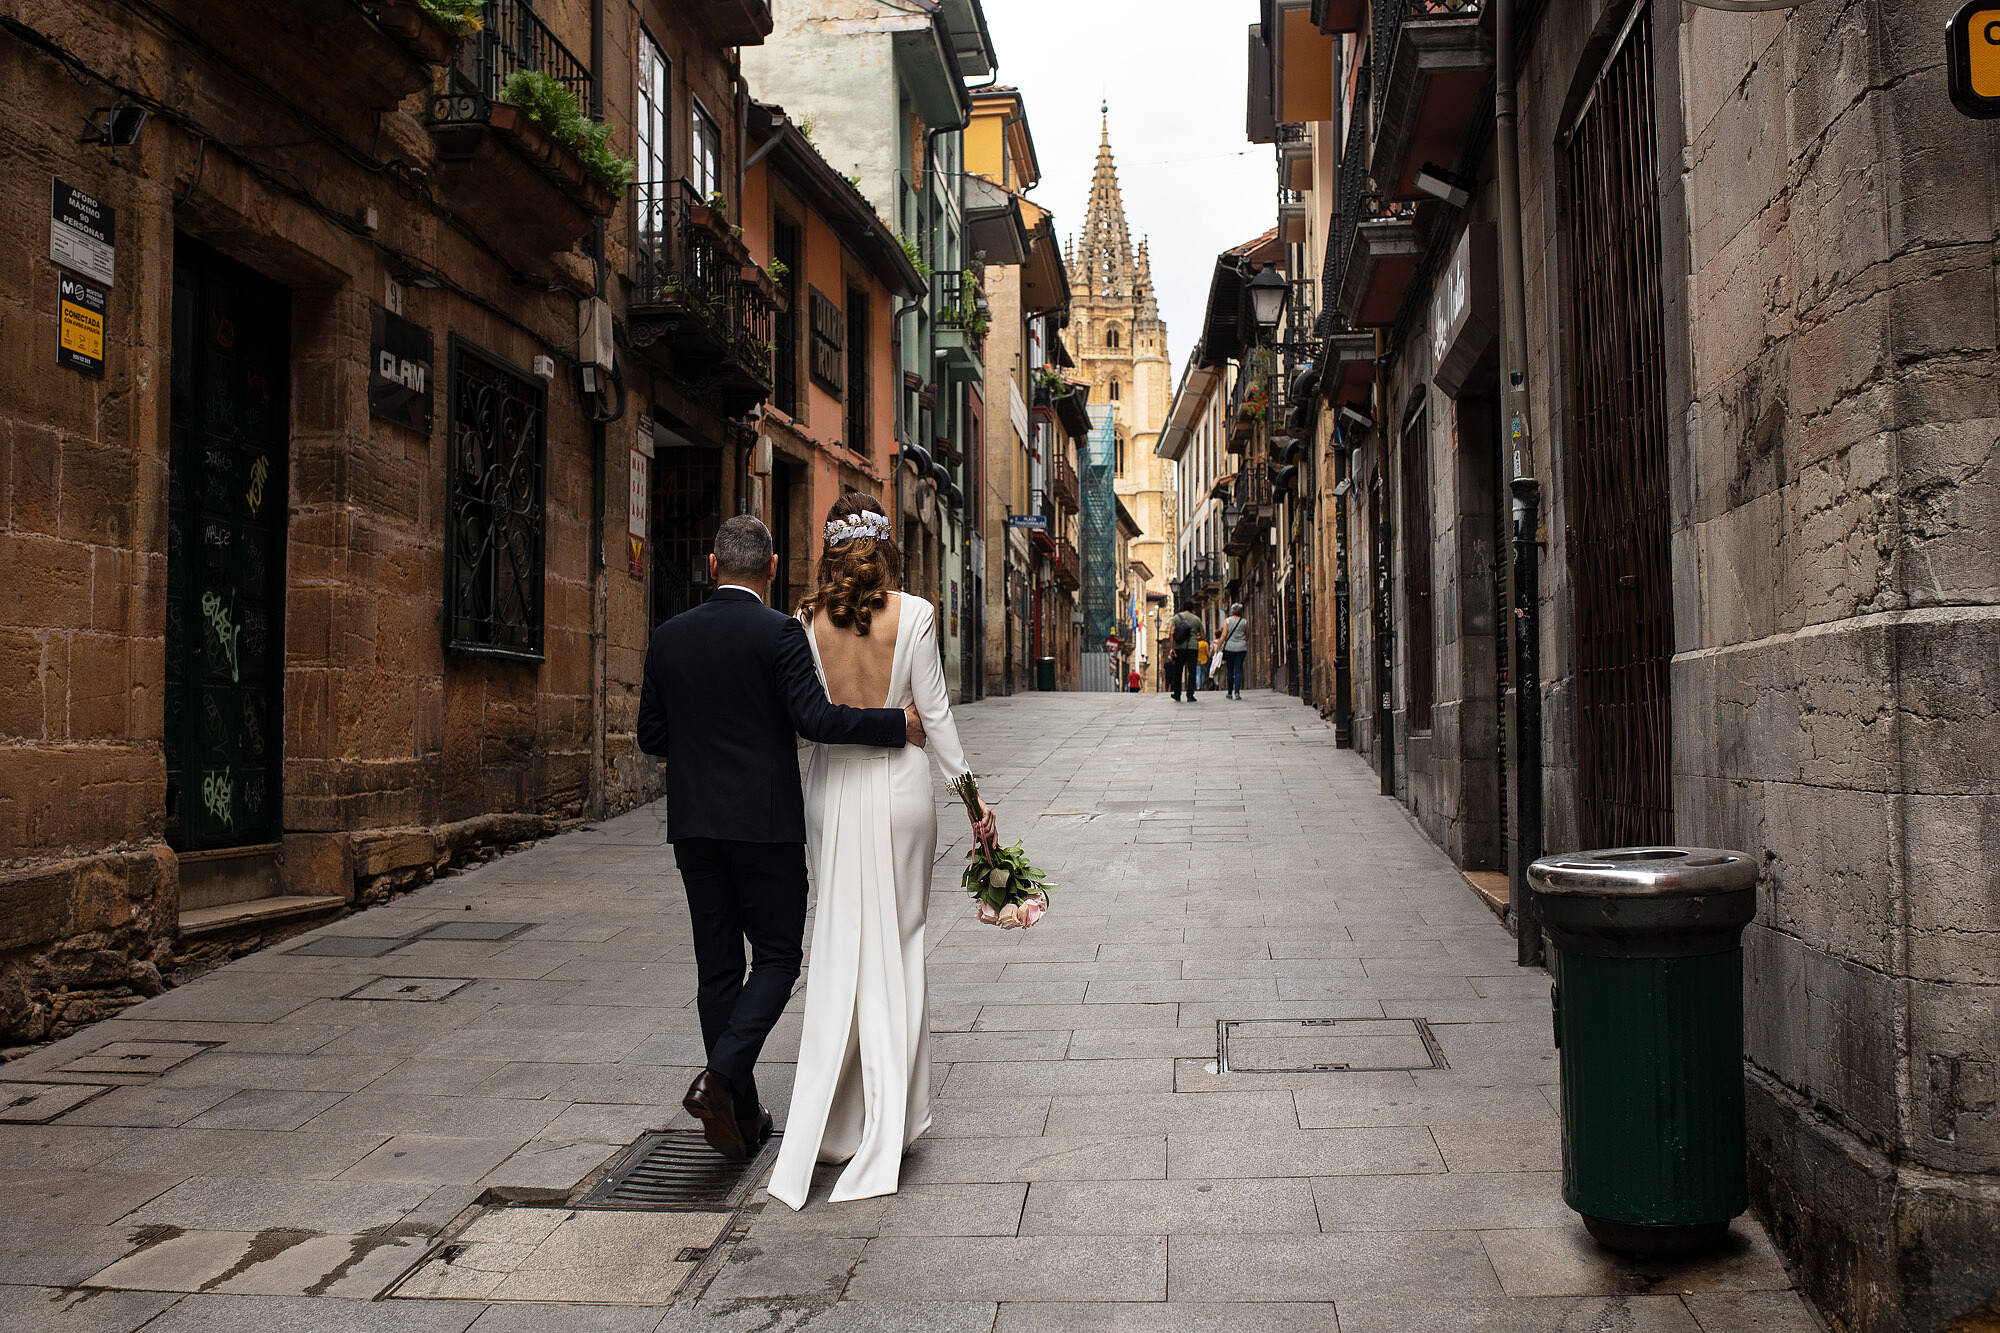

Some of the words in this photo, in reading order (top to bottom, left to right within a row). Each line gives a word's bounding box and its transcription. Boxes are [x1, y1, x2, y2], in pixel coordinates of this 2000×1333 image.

[68, 197, 101, 219] MÁXIMO
[71, 189, 98, 208] AFORO
[63, 214, 105, 241] PERSONAS
[79, 213, 89, 223] 90
[64, 308, 101, 329] CONECTADA
[816, 298, 844, 349] DIARIO
[380, 350, 425, 394] GLAM
[631, 457, 645, 475] MAR
[632, 481, 645, 498] SAL
